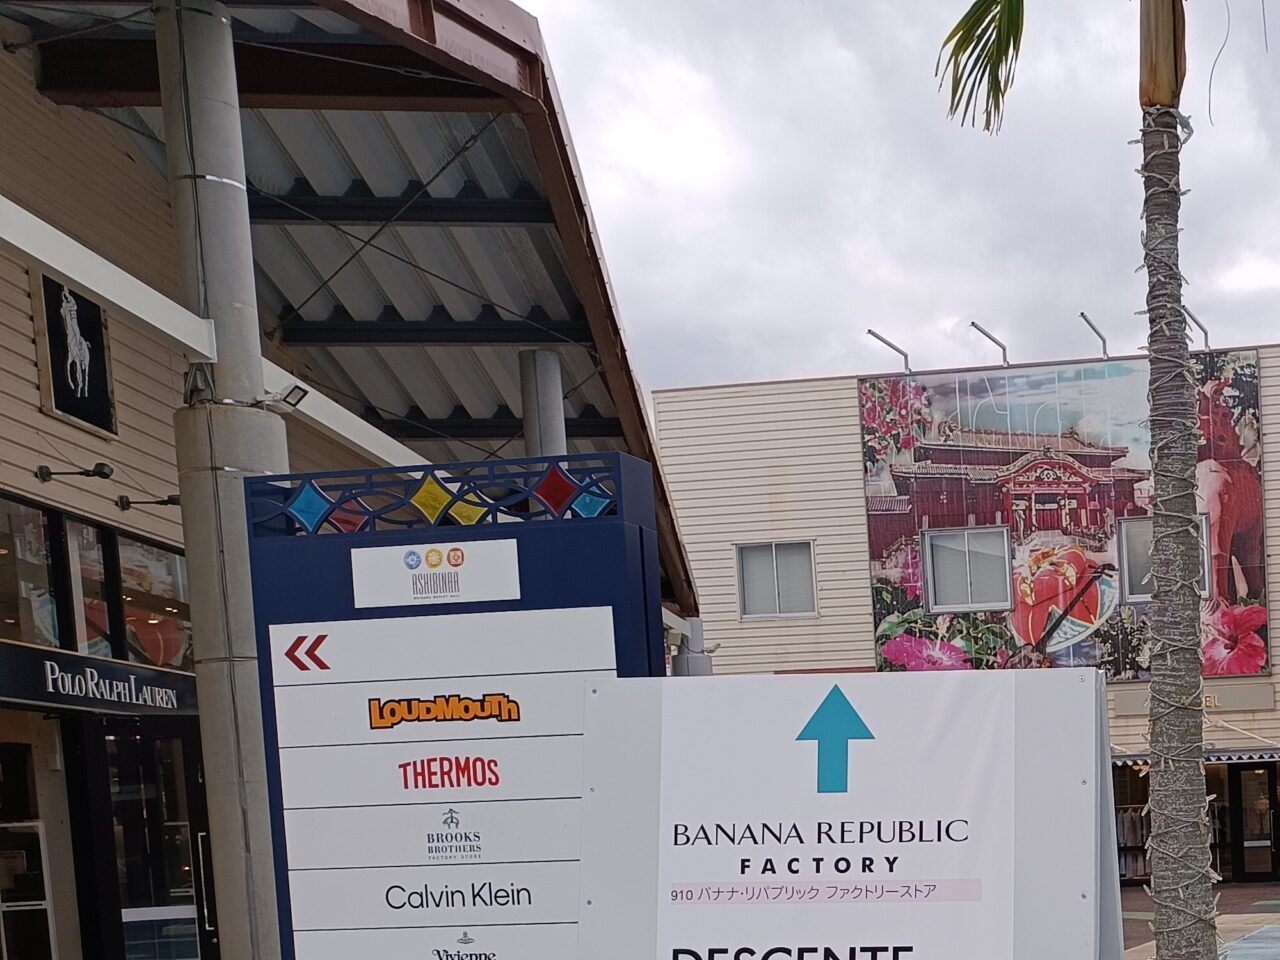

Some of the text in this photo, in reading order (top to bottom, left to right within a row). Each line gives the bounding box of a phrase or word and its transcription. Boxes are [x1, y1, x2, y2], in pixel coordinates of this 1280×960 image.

[44, 660, 178, 709] POLO RALPH LAUREN
[398, 756, 500, 790] THERMOS
[426, 831, 481, 844] BROOKS
[672, 818, 970, 847] BANANA REPUBLIC
[427, 844, 482, 854] BROTHERS
[739, 855, 900, 875] FACTORY
[385, 881, 532, 910] Calvin Klein
[670, 890, 694, 901] 910
[826, 883, 937, 899] ファクトリーストア
